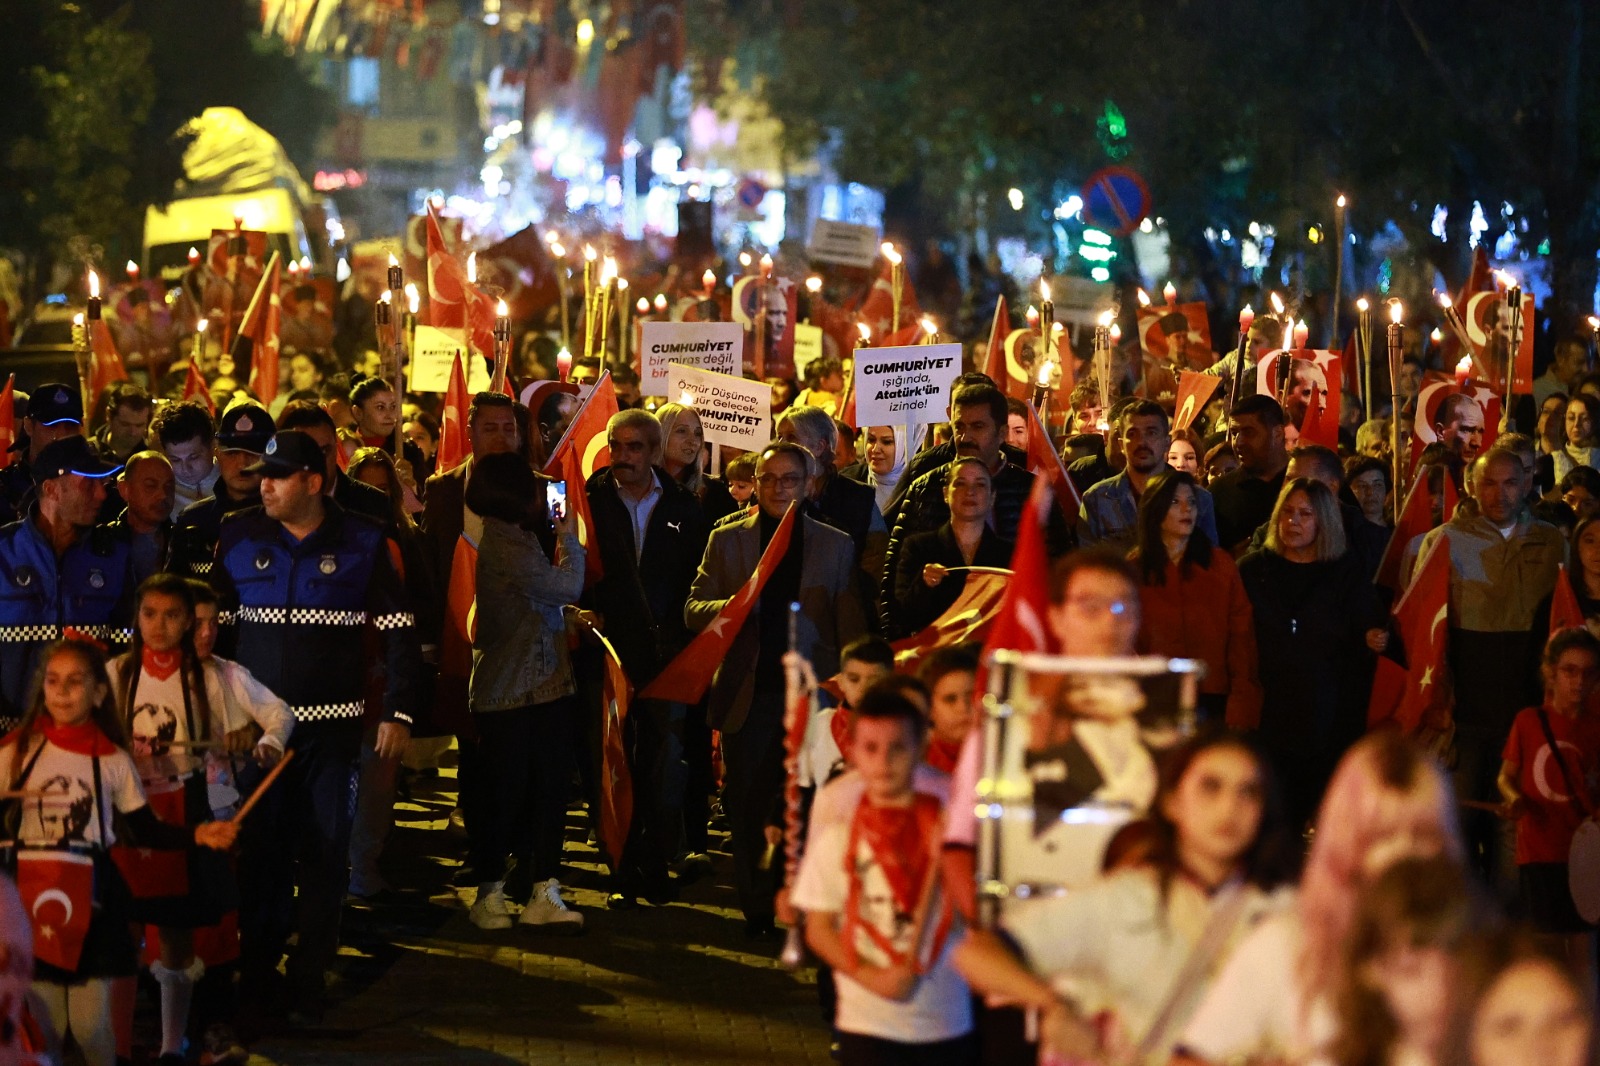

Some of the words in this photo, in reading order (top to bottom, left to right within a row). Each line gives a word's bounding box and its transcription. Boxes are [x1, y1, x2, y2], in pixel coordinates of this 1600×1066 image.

[651, 339, 733, 353] CUMHURİYET
[648, 356, 666, 366] bir
[703, 353, 734, 366] değil,
[863, 357, 953, 375] CUMHURİYET
[651, 368, 669, 378] bir
[882, 373, 931, 388] ışığında,
[678, 379, 710, 393] Özgür
[711, 388, 758, 405] Düşünce,
[874, 384, 940, 401] Atatürk'ün
[713, 399, 758, 414] Gelecek,
[889, 399, 928, 412] izinde!
[694, 408, 762, 426] MHURİYET
[730, 425, 755, 437] Dek!
